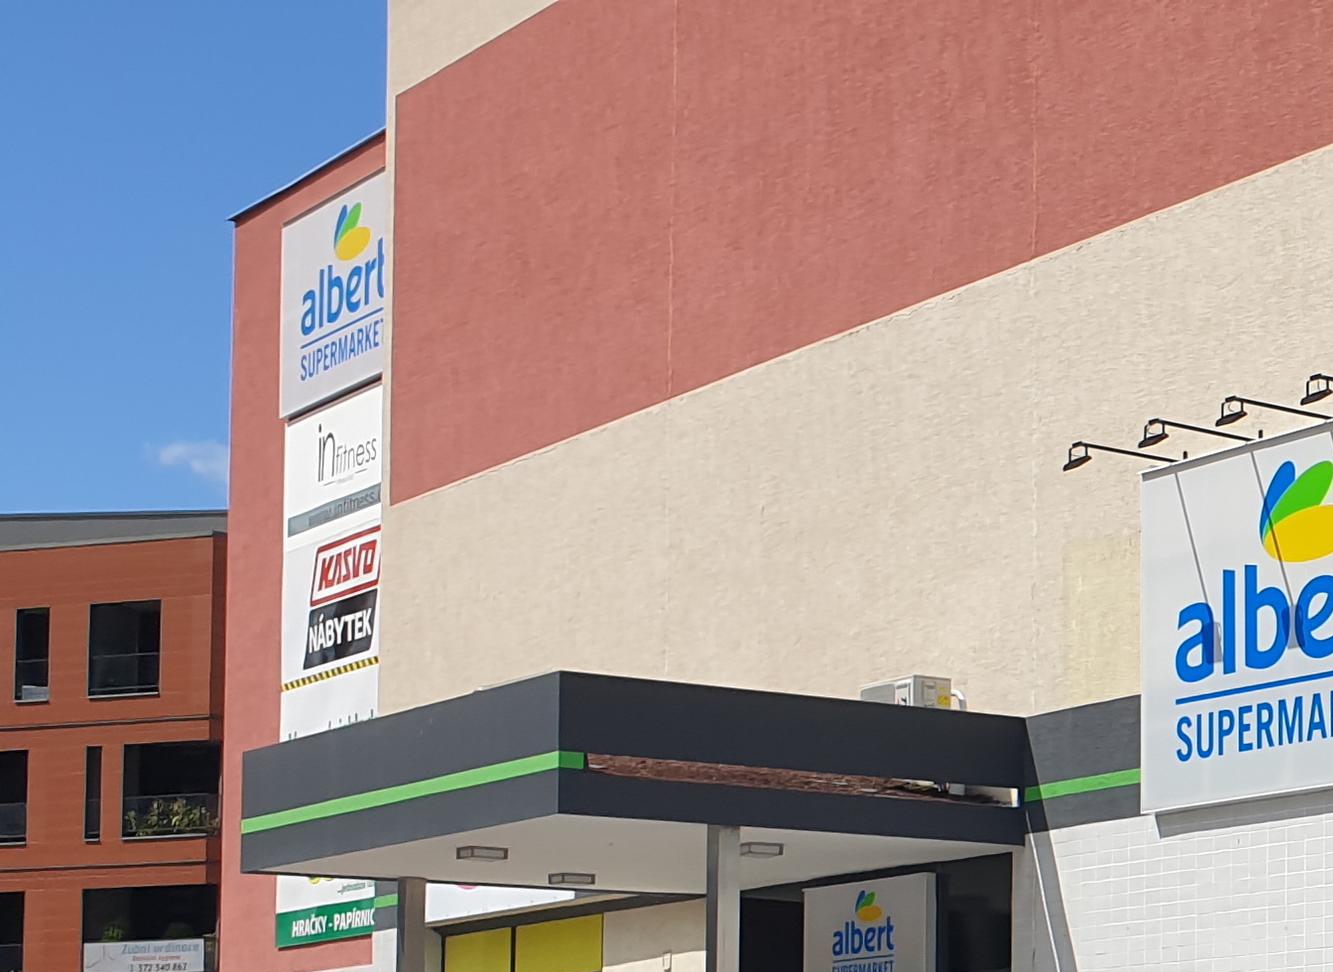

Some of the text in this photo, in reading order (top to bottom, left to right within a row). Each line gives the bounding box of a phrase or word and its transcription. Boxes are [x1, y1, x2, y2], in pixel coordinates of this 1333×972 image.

[301, 237, 384, 336] albert
[317, 539, 378, 592] KASVO
[308, 608, 373, 653] NÁBYTEK
[291, 913, 327, 938] HRAČKY
[832, 916, 894, 957] albert
